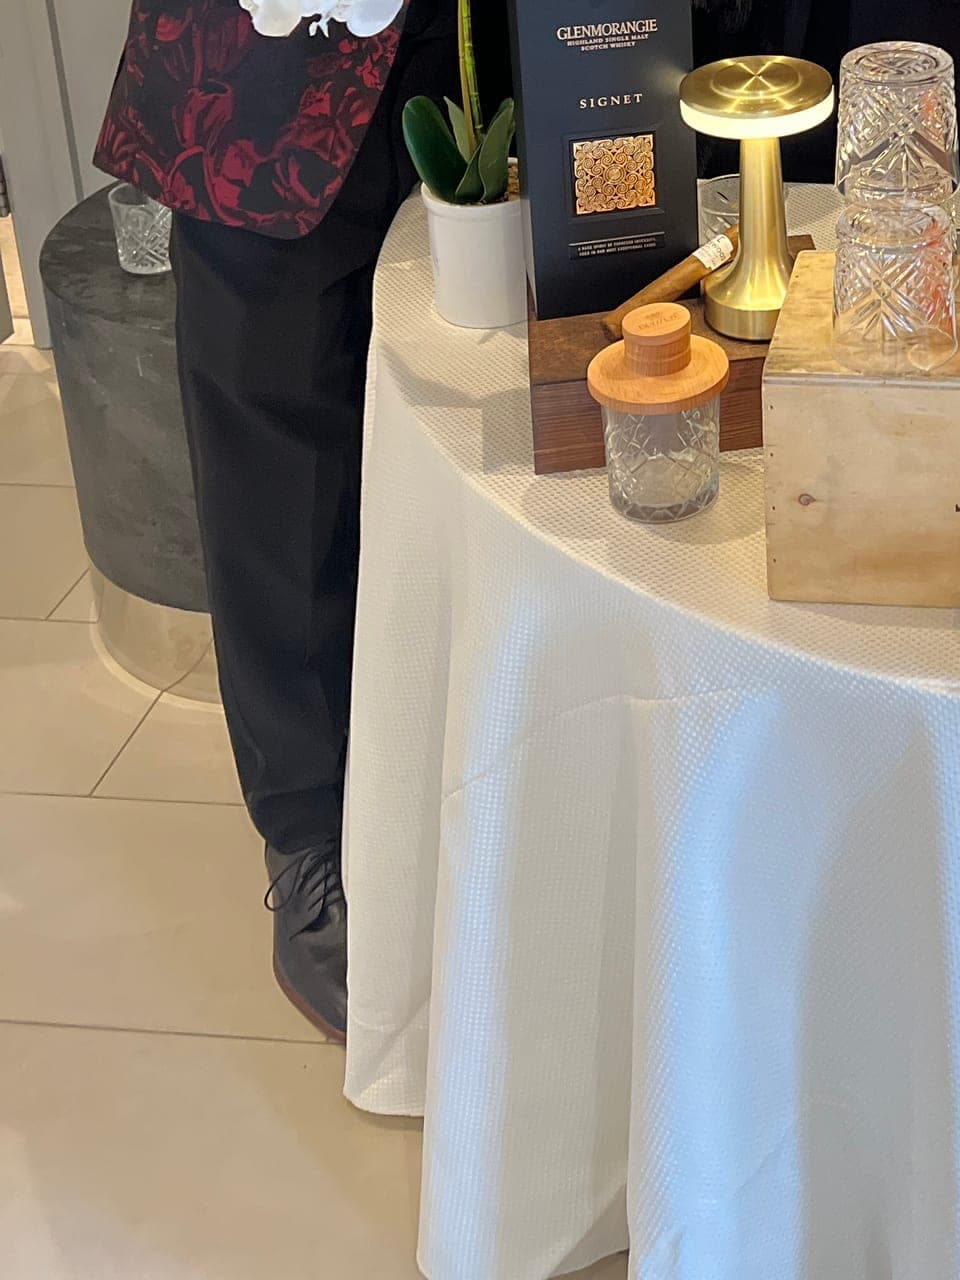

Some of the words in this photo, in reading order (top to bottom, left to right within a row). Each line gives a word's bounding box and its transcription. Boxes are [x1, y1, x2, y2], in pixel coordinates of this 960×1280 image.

[556, 19, 658, 40] GLENMORANGIE
[580, 43, 609, 51] SCOTCH
[609, 41, 636, 49] WHISKY
[579, 93, 643, 109] SIGNET
